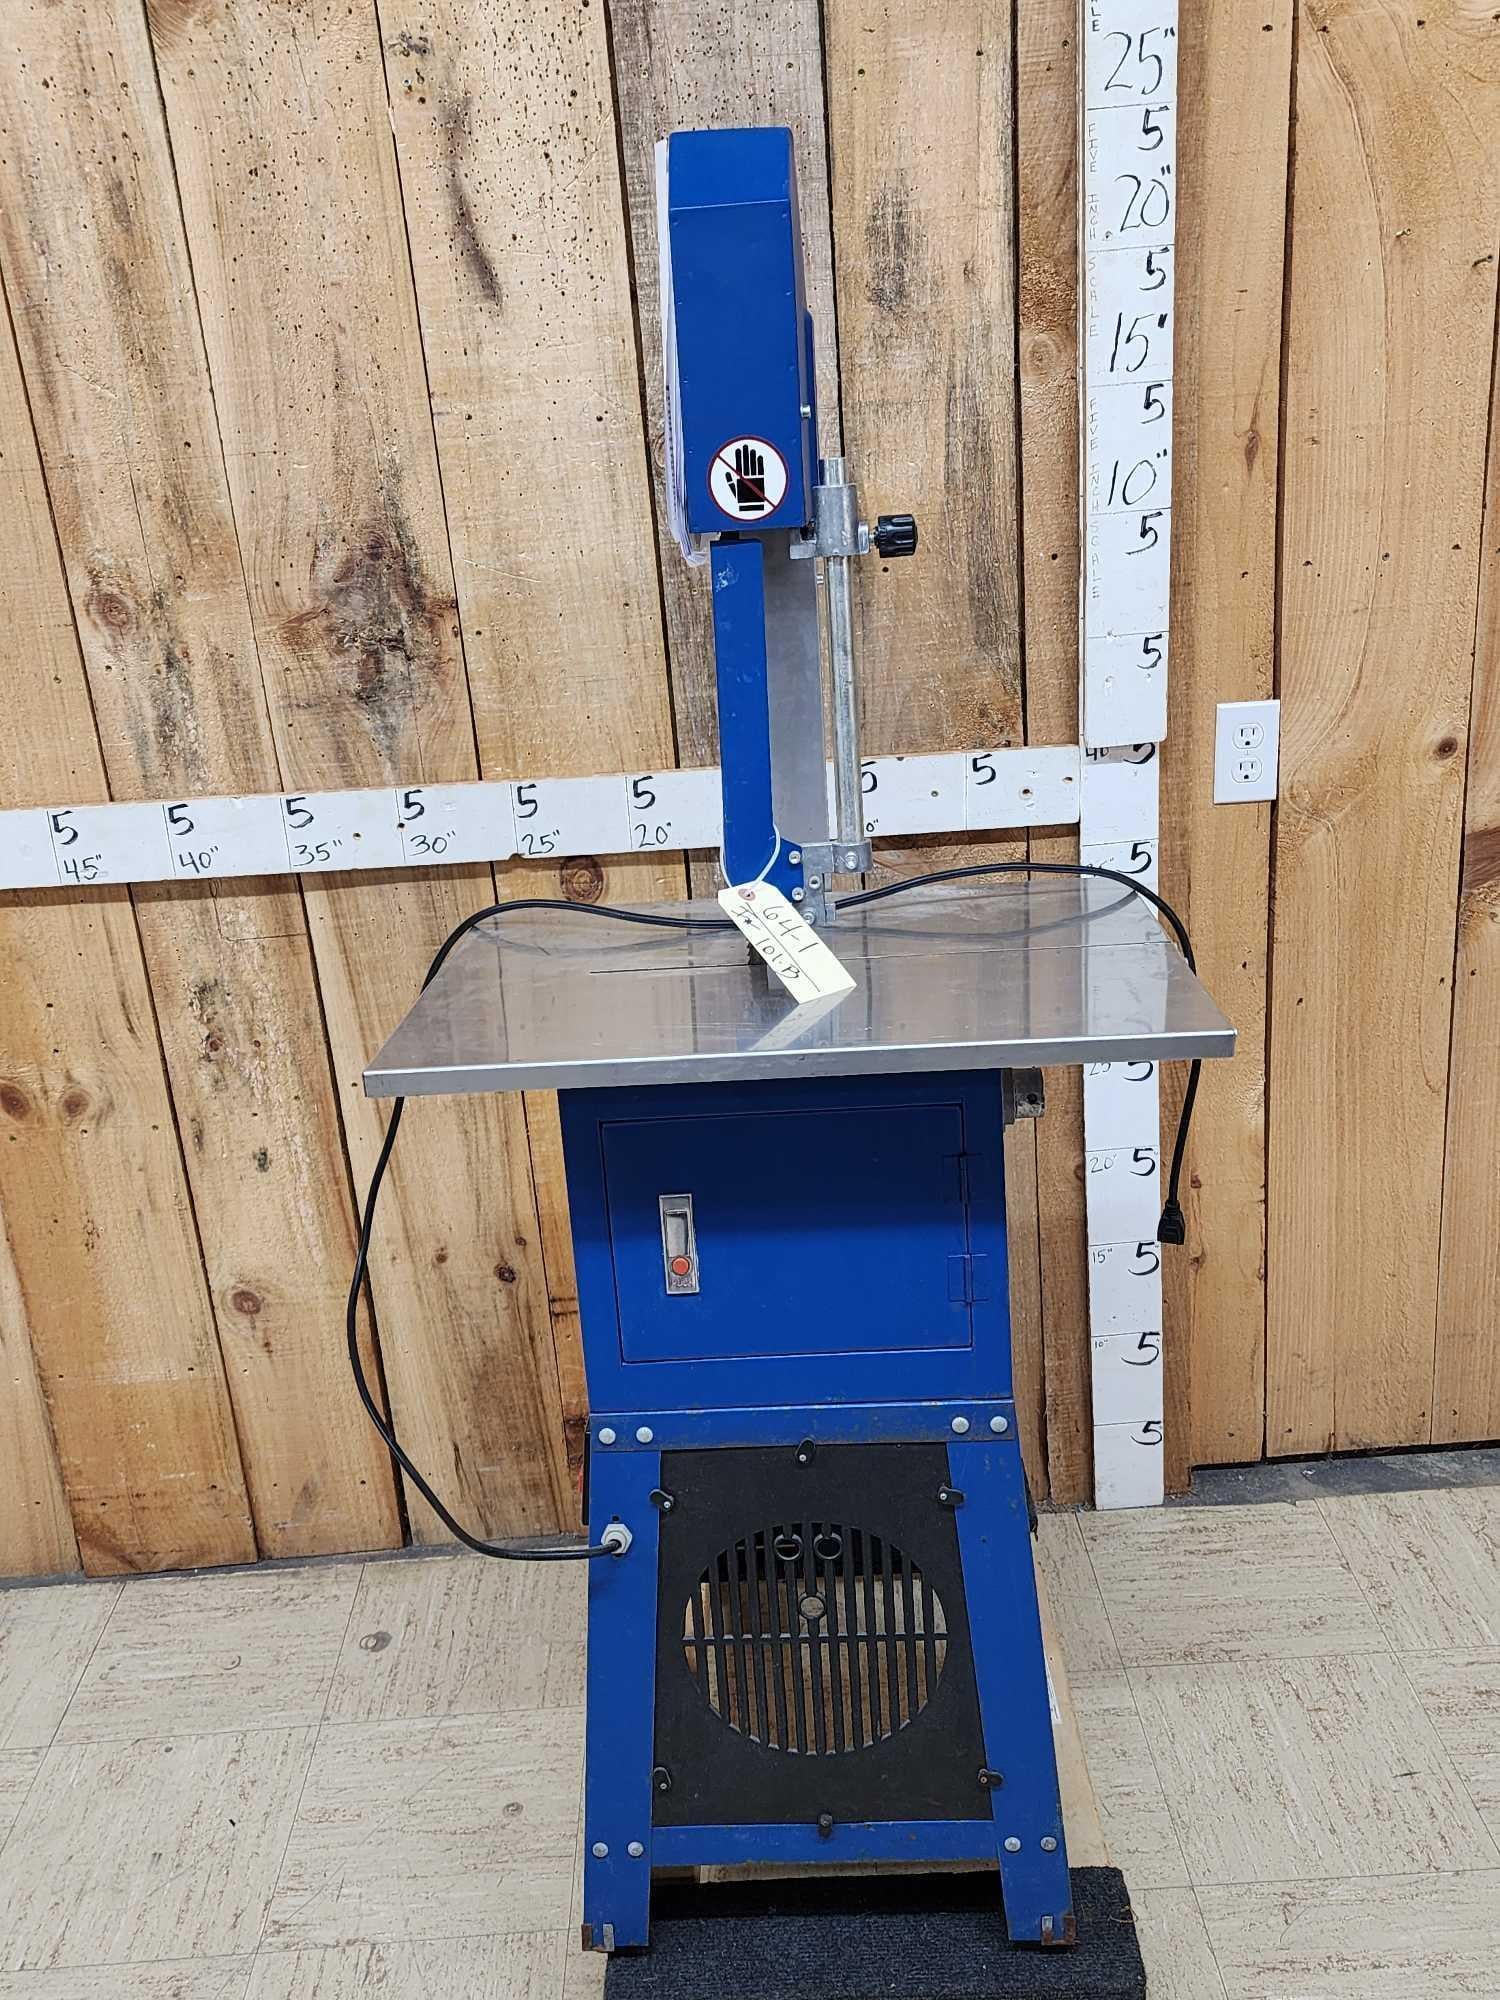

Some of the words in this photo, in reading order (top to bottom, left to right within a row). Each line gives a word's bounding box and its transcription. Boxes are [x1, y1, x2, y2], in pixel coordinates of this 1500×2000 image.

[1103, 27, 1176, 95] 25"
[1137, 105, 1170, 151] 5
[1114, 164, 1171, 232] 20"
[1139, 246, 1170, 291] 5
[1109, 312, 1169, 372] 15"
[1140, 383, 1165, 424] 5
[1107, 448, 1168, 506] 10"
[1125, 511, 1163, 556] 5
[1136, 633, 1163, 670] 5
[972, 753, 997, 786] 5
[403, 789, 425, 820] 5
[516, 783, 538, 818] 5
[631, 776, 656, 809] 5
[51, 811, 78, 845] 5
[168, 804, 194, 835] 5
[284, 797, 314, 829] 5
[292, 840, 343, 867] 35"
[409, 829, 456, 856] 30"
[521, 829, 561, 855] 25"
[64, 854, 101, 883] 45"
[179, 845, 218, 874] 40"
[1092, 1248, 1112, 1263] 15"
[1130, 1421, 1162, 1445] 5
